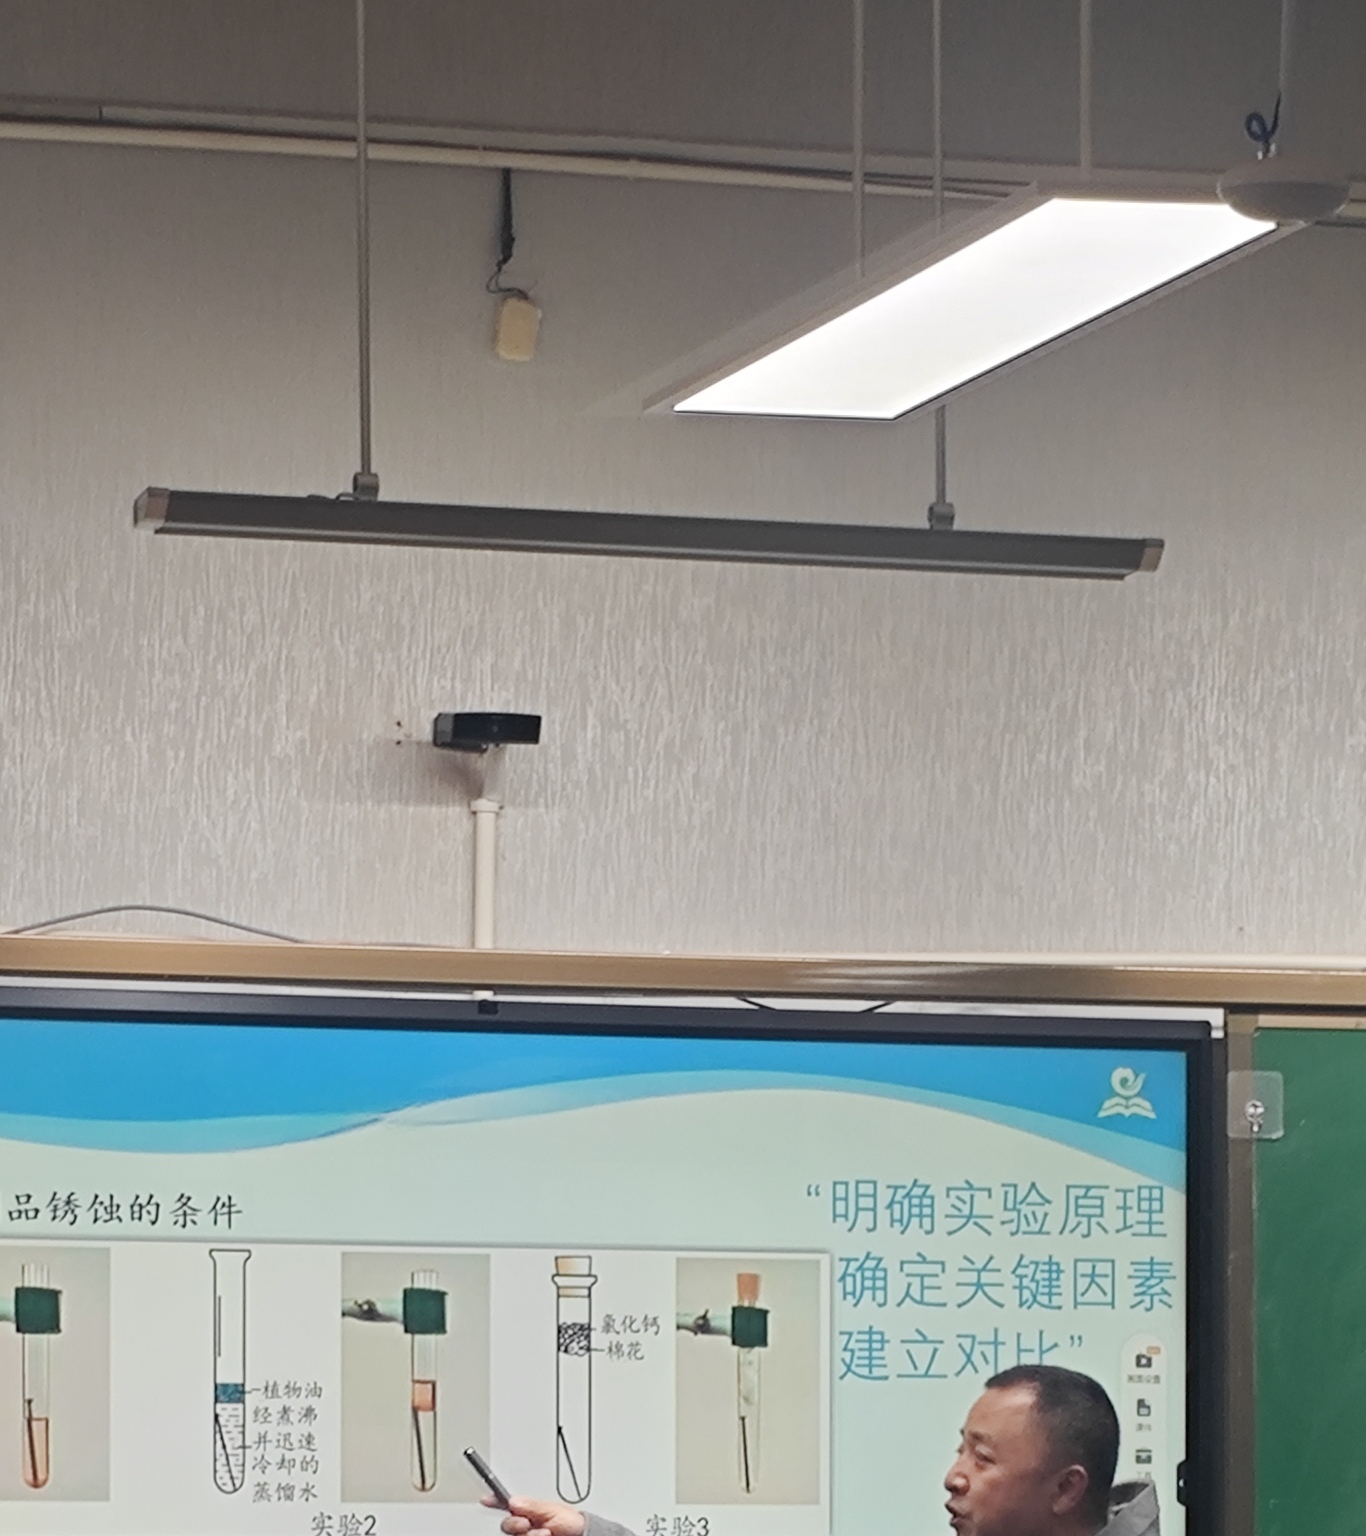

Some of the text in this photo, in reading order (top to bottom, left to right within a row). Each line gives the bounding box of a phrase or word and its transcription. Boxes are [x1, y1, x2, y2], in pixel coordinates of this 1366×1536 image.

[807, 1178, 1169, 1238] “明确实验原理
[838, 1252, 1177, 1312] 确定关键因素
[607, 1341, 645, 1361] 棉花
[263, 1380, 323, 1399] 植物油
[253, 1404, 318, 1426] 经煮沸
[253, 1431, 318, 1452] 并迅速
[252, 1453, 319, 1475] 冷却的
[253, 1482, 318, 1503] 蒸馏水
